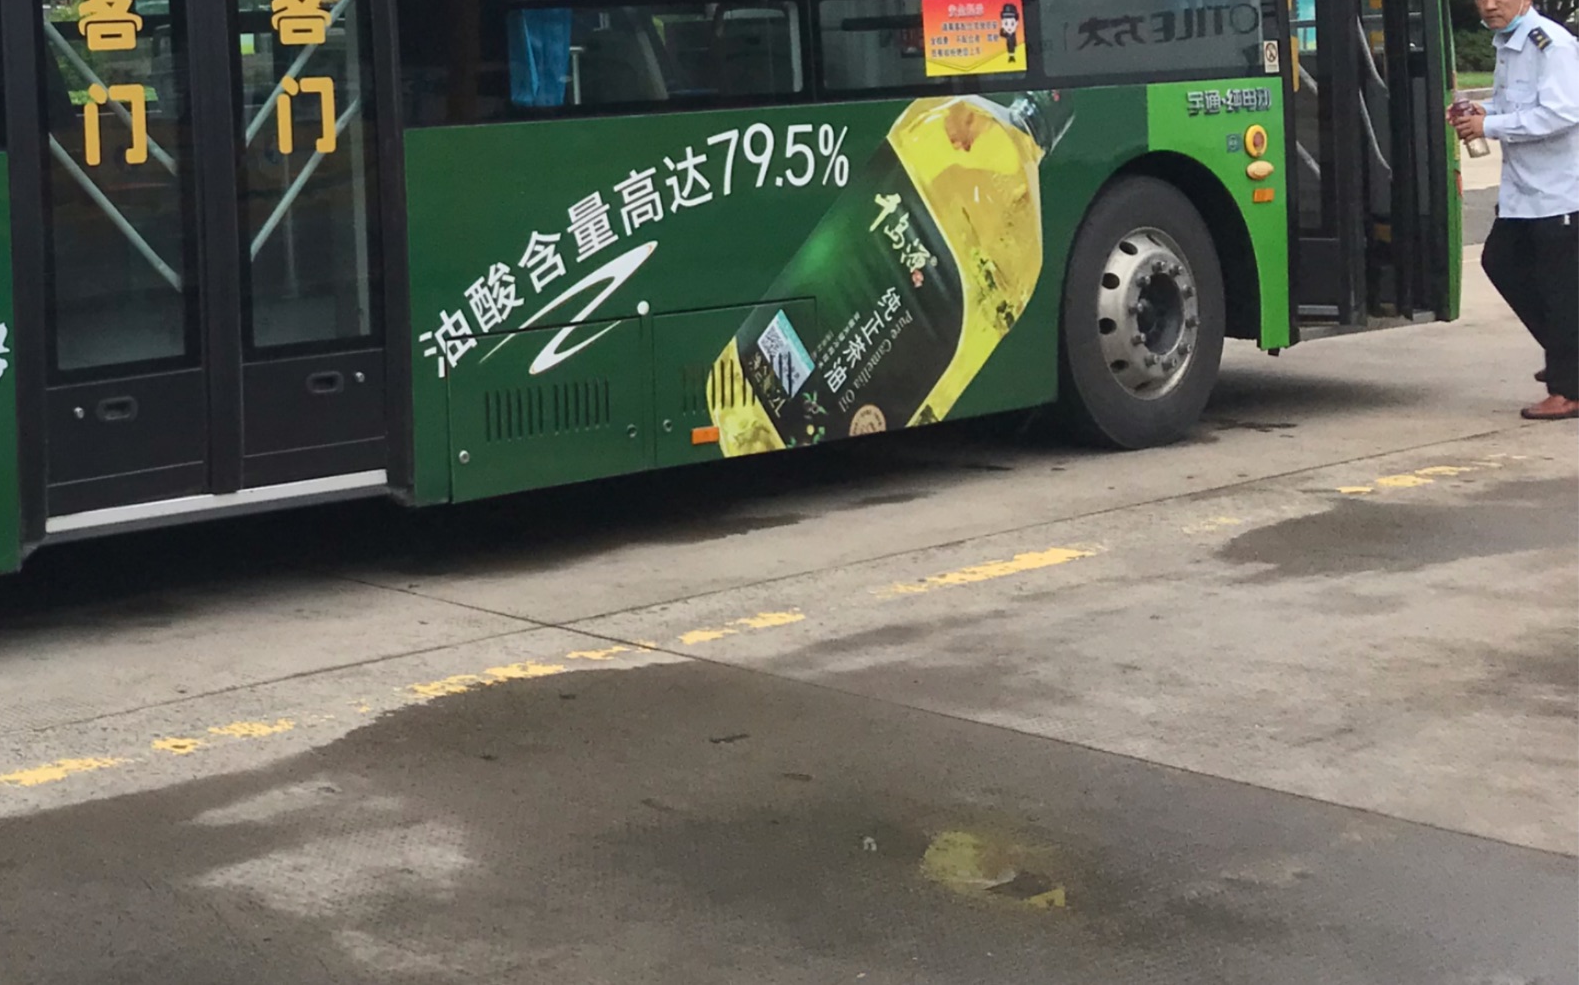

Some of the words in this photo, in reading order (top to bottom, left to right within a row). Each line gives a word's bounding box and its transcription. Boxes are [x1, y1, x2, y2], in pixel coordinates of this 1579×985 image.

[419, 122, 850, 378] 油酸含量高达79.5%
[824, 287, 902, 393] 纯正茶油
[890, 310, 913, 340] Pure
[853, 338, 893, 390] Camellia
[838, 388, 855, 412] Oil
